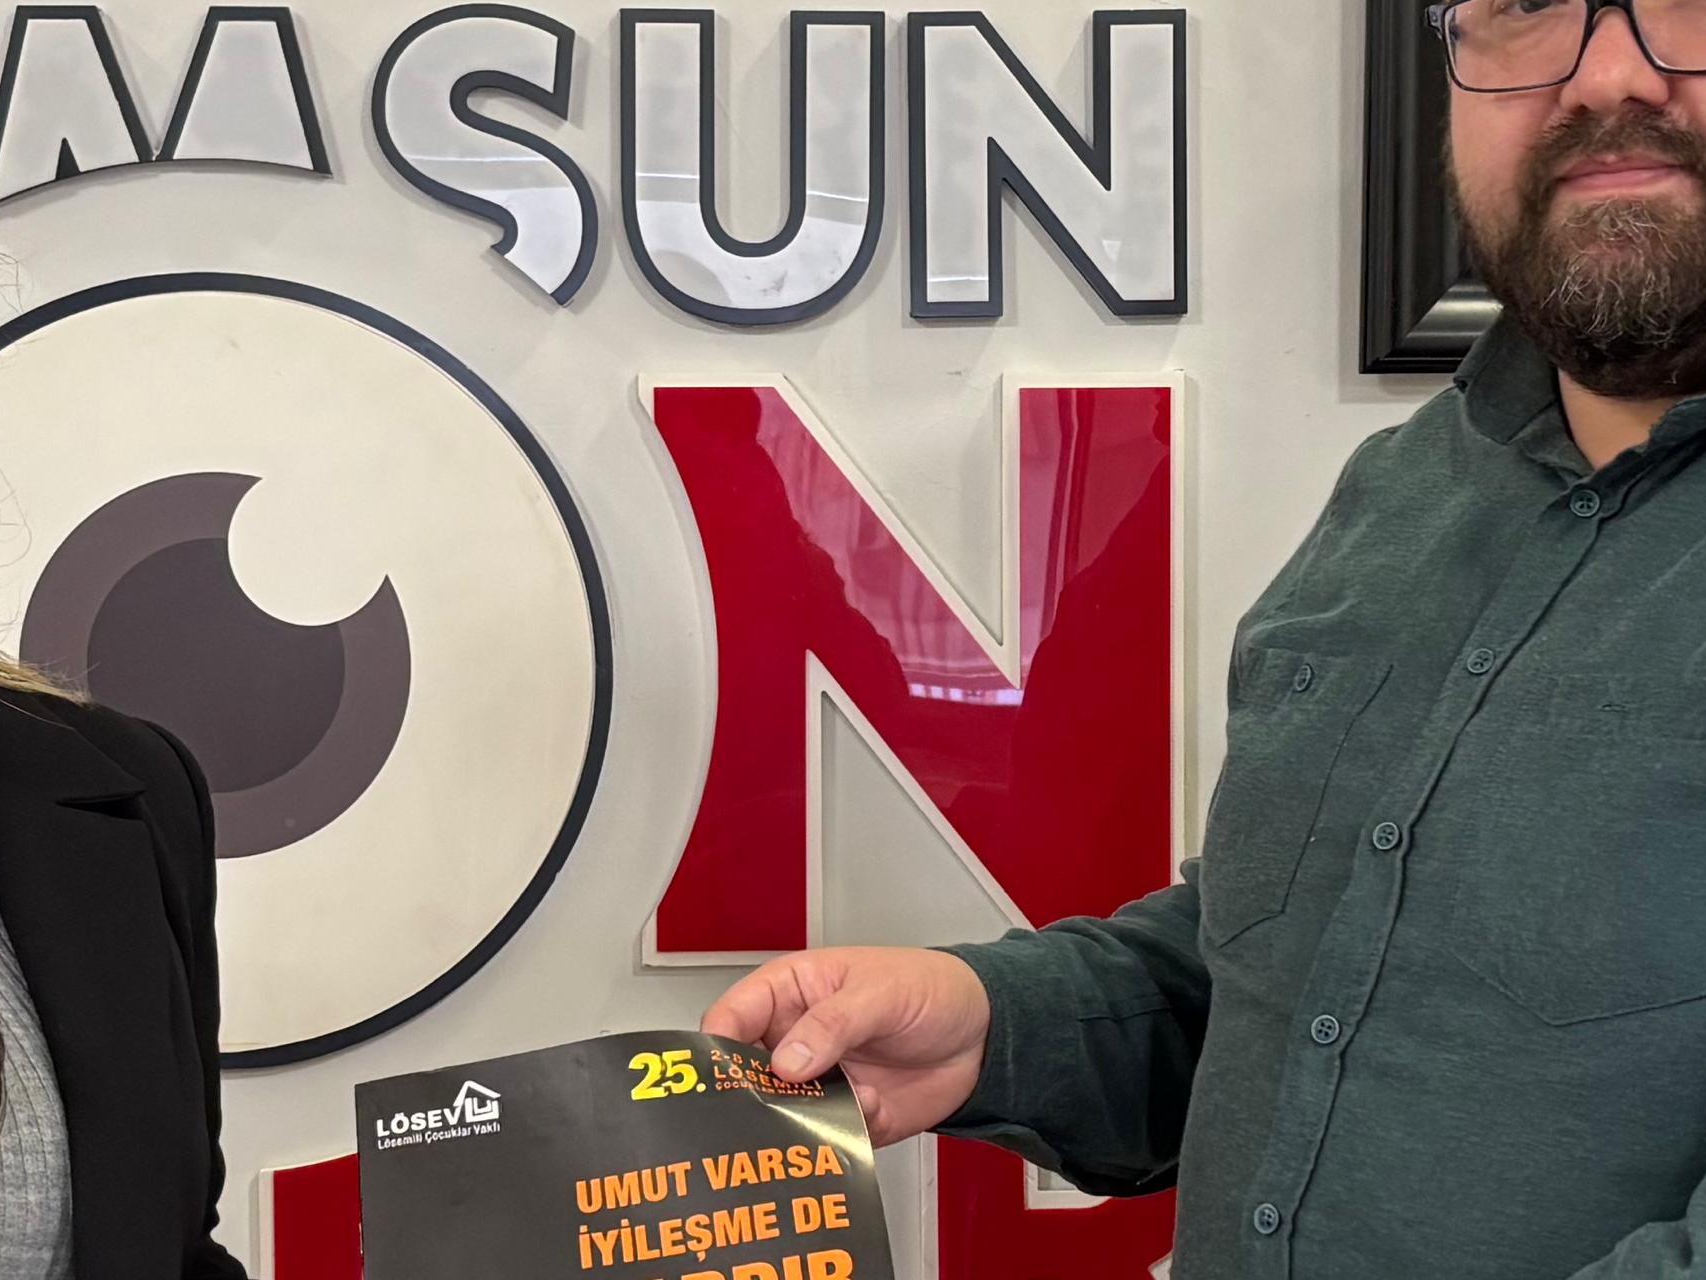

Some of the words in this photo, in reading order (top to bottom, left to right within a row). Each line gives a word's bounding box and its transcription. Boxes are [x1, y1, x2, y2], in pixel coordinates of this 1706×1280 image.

[628, 1049, 706, 1100] 25.
[376, 1107, 463, 1137] LÖSEV
[377, 1132, 423, 1150] Lösemili
[425, 1125, 471, 1144] Çocuklar
[576, 1161, 691, 1213] UMUT
[702, 1145, 843, 1191] VARSA
[578, 1202, 780, 1269] İYİLEŞME
[792, 1193, 850, 1234] DE
